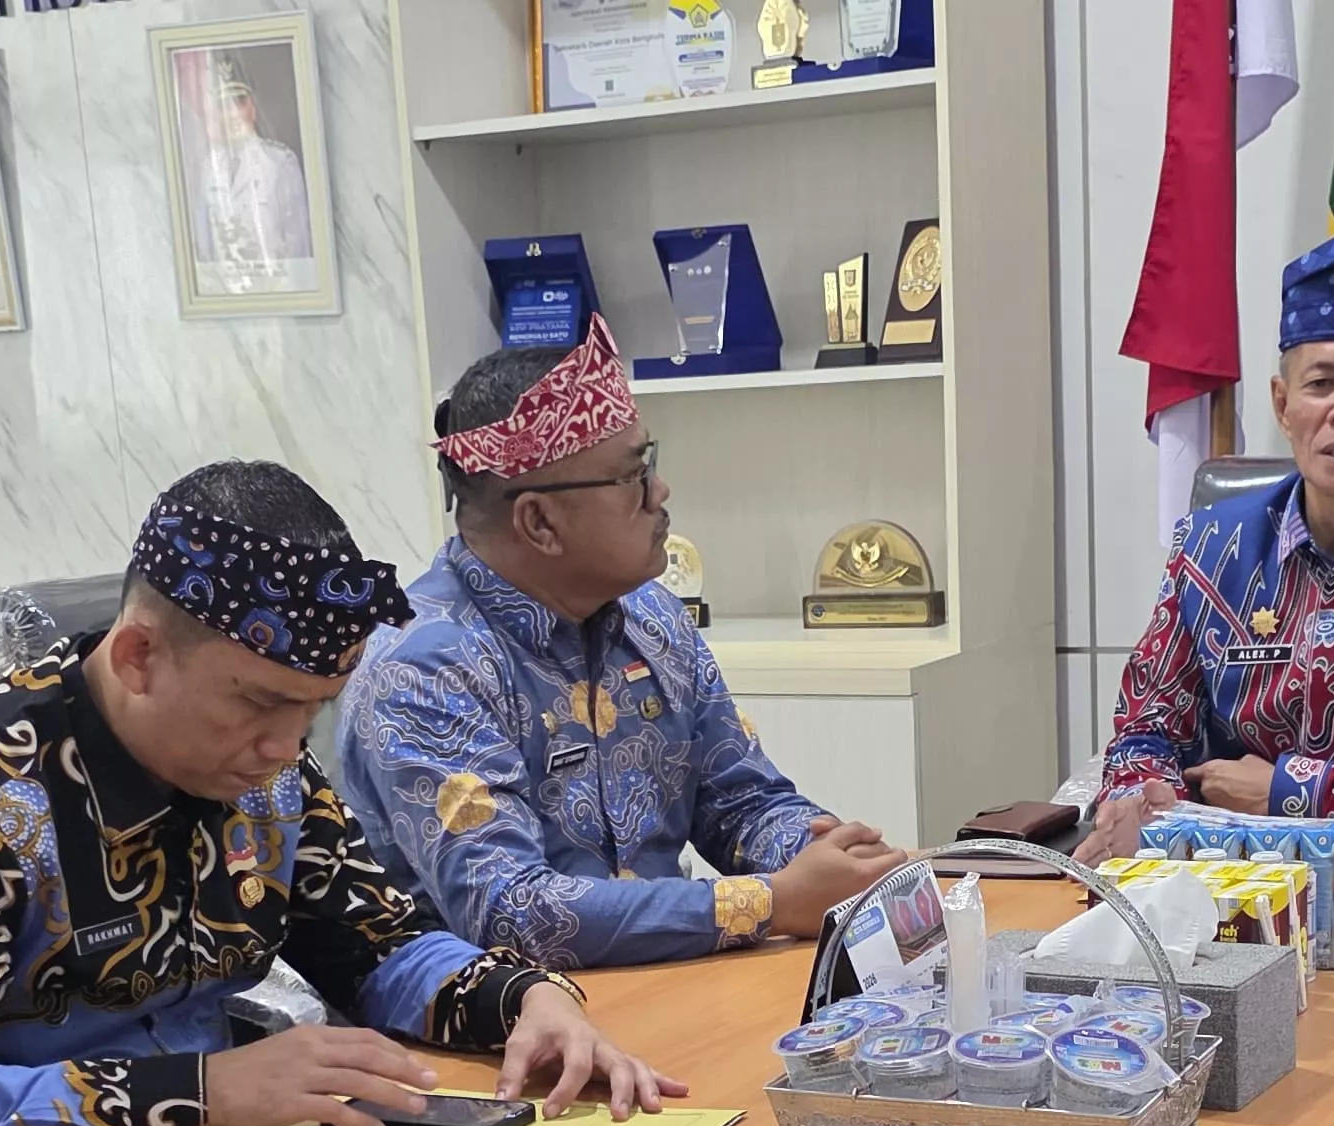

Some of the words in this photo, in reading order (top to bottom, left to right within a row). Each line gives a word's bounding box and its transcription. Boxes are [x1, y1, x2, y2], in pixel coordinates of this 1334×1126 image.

[1273, 648, 1281, 659] P
[87, 922, 134, 945] RAKHMAT
[863, 972, 877, 989] 2026
